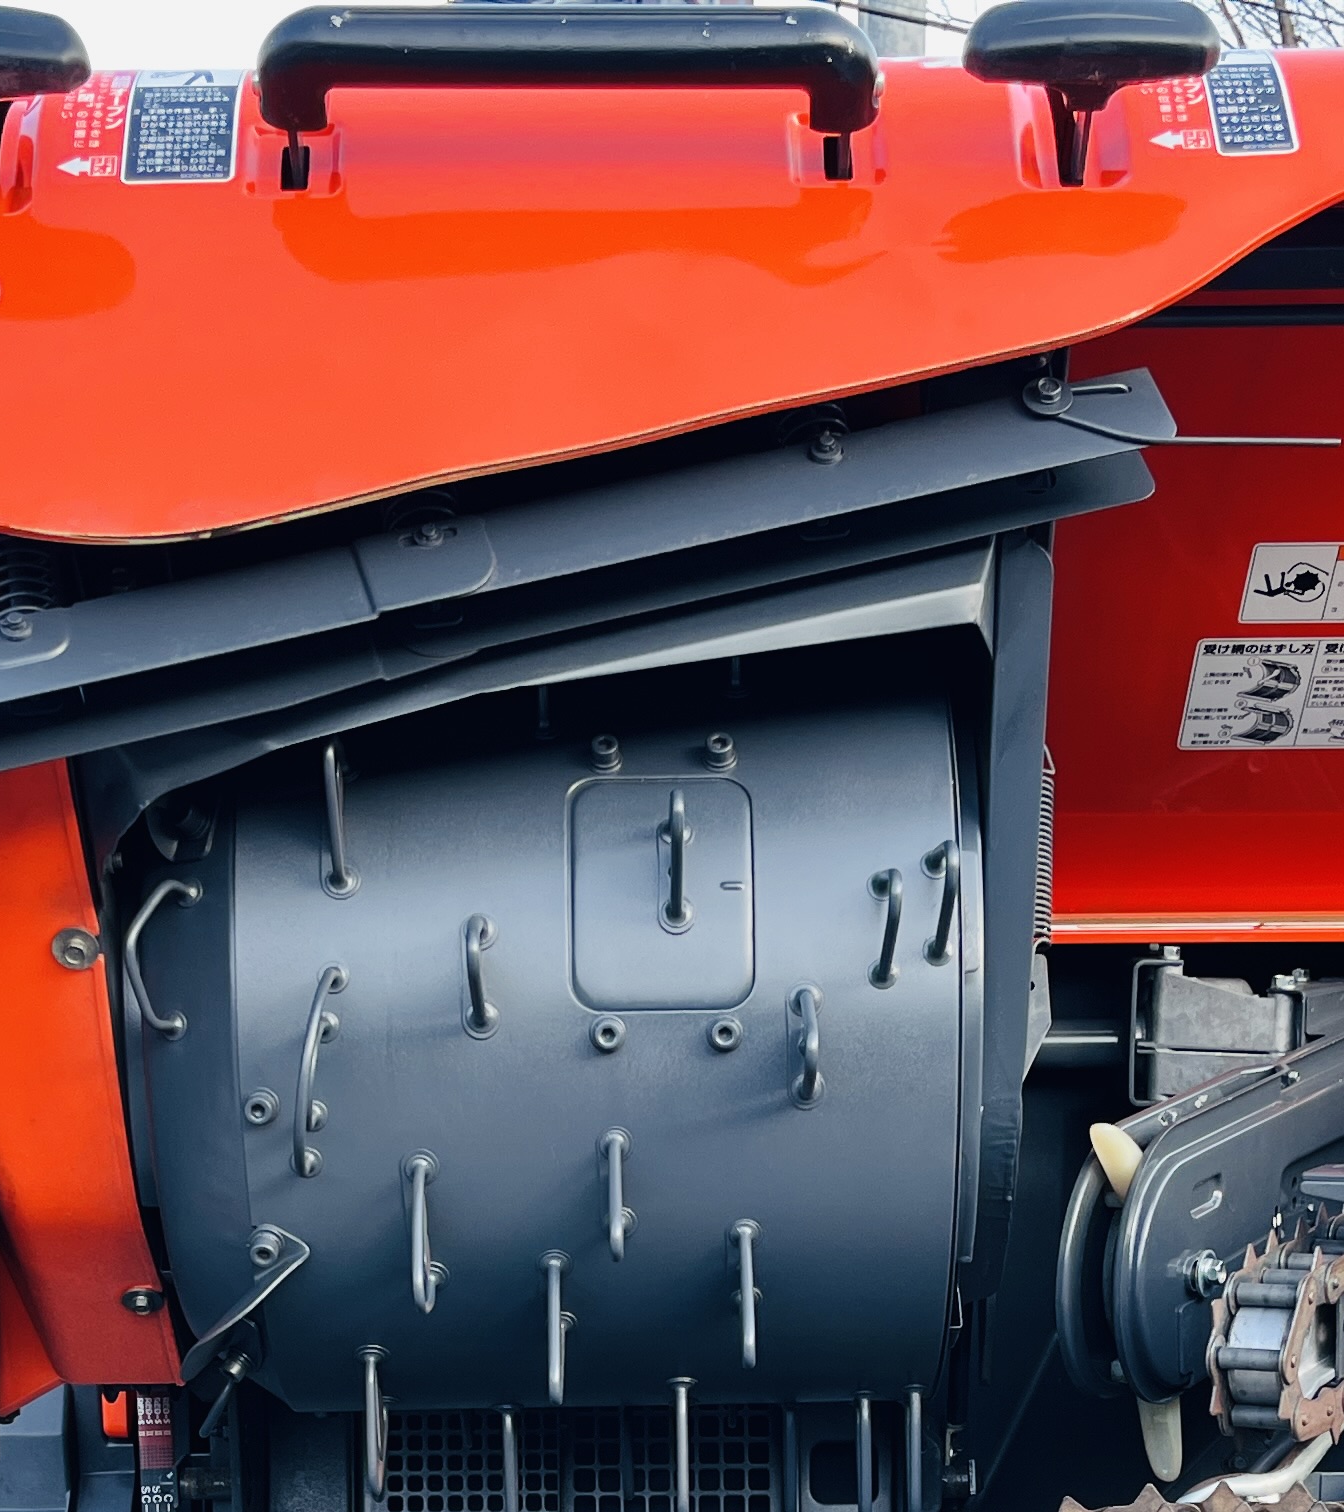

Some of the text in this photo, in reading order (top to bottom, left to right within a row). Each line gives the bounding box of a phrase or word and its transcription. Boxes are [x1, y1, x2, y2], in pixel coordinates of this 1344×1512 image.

[1202, 643, 1315, 655] 受け網のはずし方
